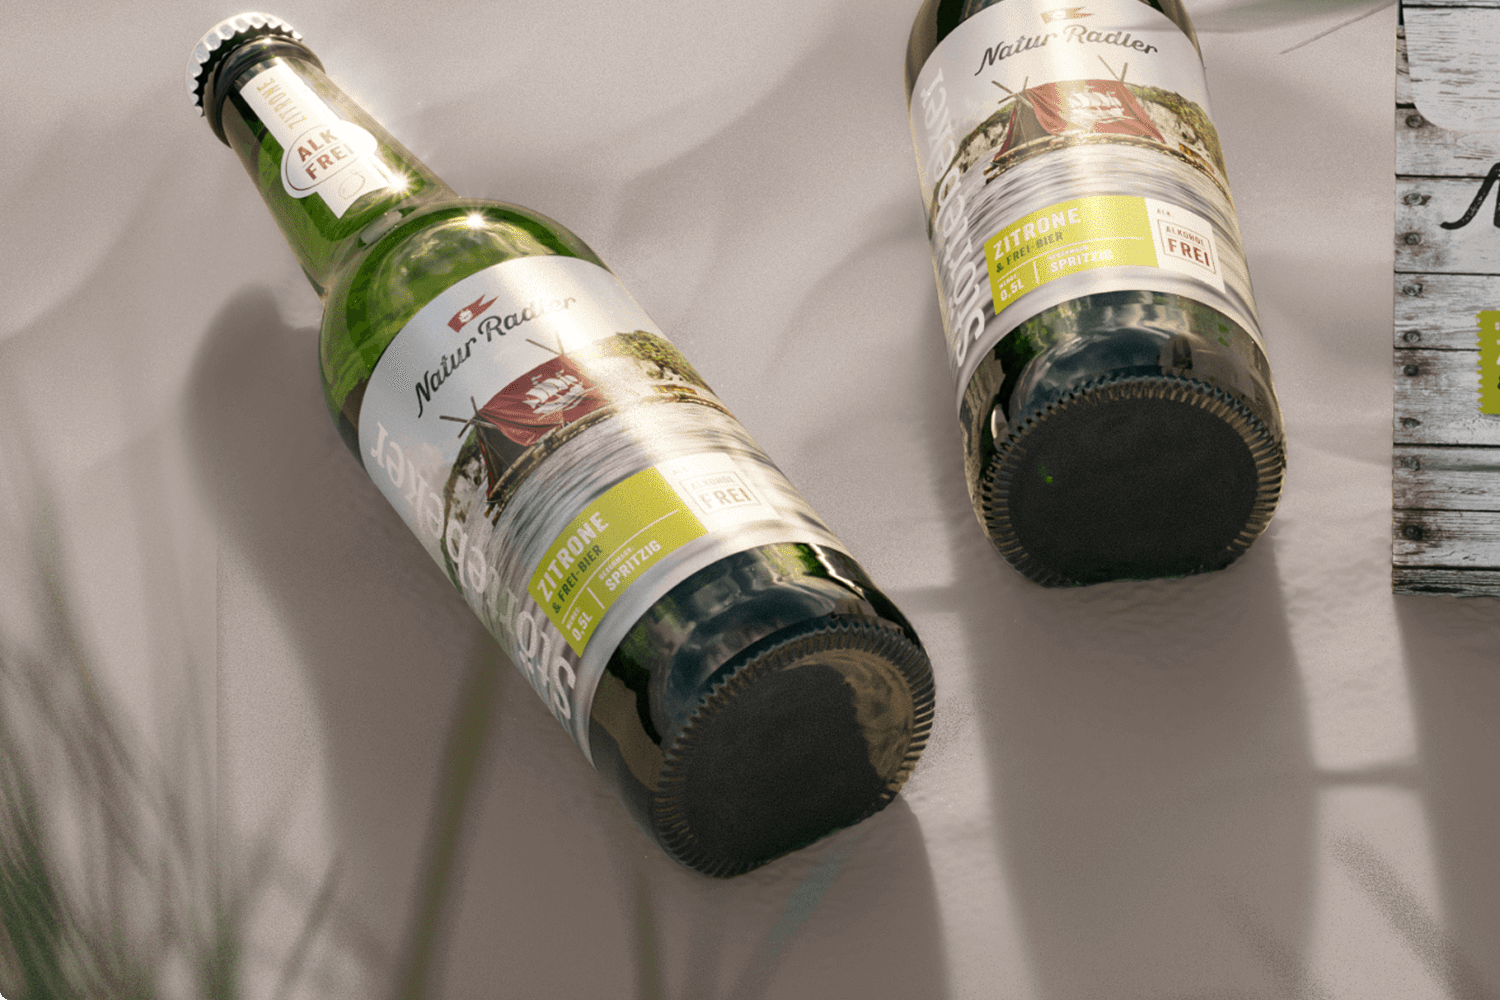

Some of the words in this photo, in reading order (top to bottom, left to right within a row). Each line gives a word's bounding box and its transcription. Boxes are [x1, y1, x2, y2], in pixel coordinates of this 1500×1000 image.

[974, 33, 1057, 76] Natur
[1063, 24, 1158, 54] Radler
[297, 129, 337, 162] ALK
[993, 207, 1081, 261] ZITRONE
[1168, 238, 1210, 267] FREI
[415, 337, 477, 419] Natur
[537, 511, 609, 602] ZITRONE
[552, 602, 562, 614] &
[557, 544, 603, 603] FREI-BIER
[605, 540, 662, 591] SPRITZIG
[571, 612, 593, 641] 0,5L
